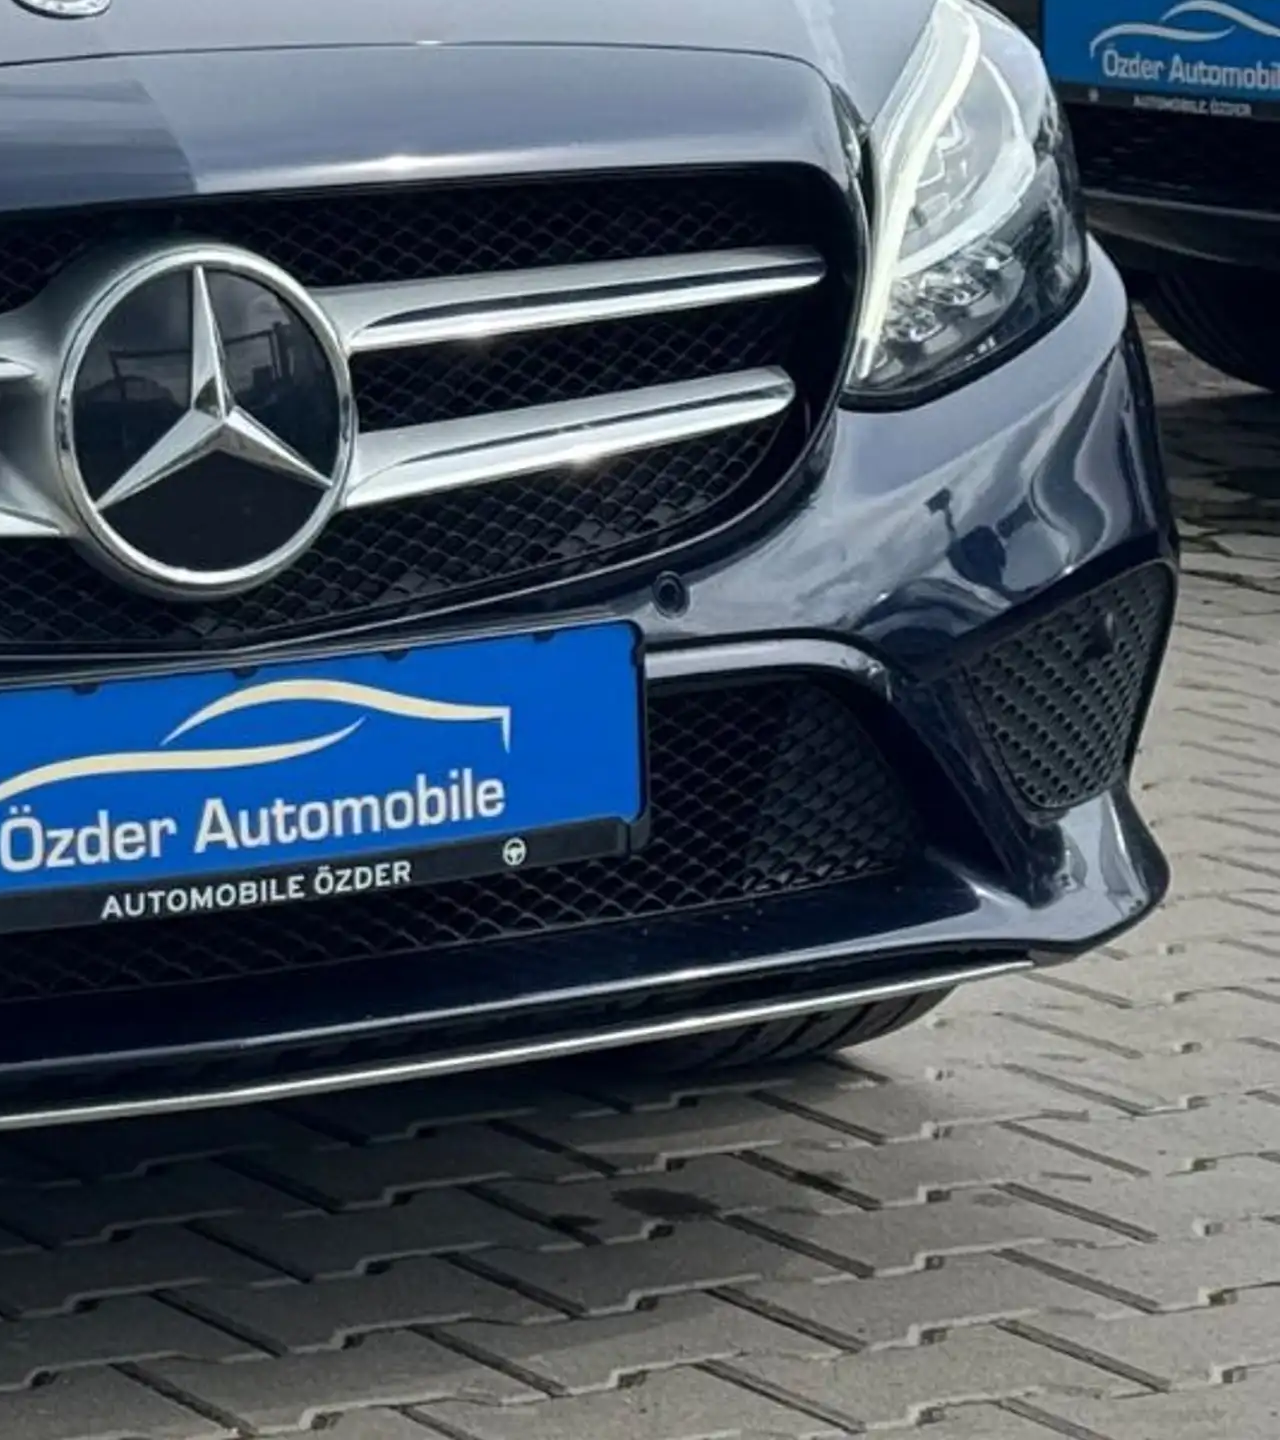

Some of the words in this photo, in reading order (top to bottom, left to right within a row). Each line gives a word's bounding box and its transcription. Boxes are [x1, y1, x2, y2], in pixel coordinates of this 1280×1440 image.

[1101, 42, 1164, 81] Özder
[192, 766, 507, 855] Automobile
[100, 872, 305, 921] AUTOMOBILE
[313, 857, 412, 897] ÖZDER
